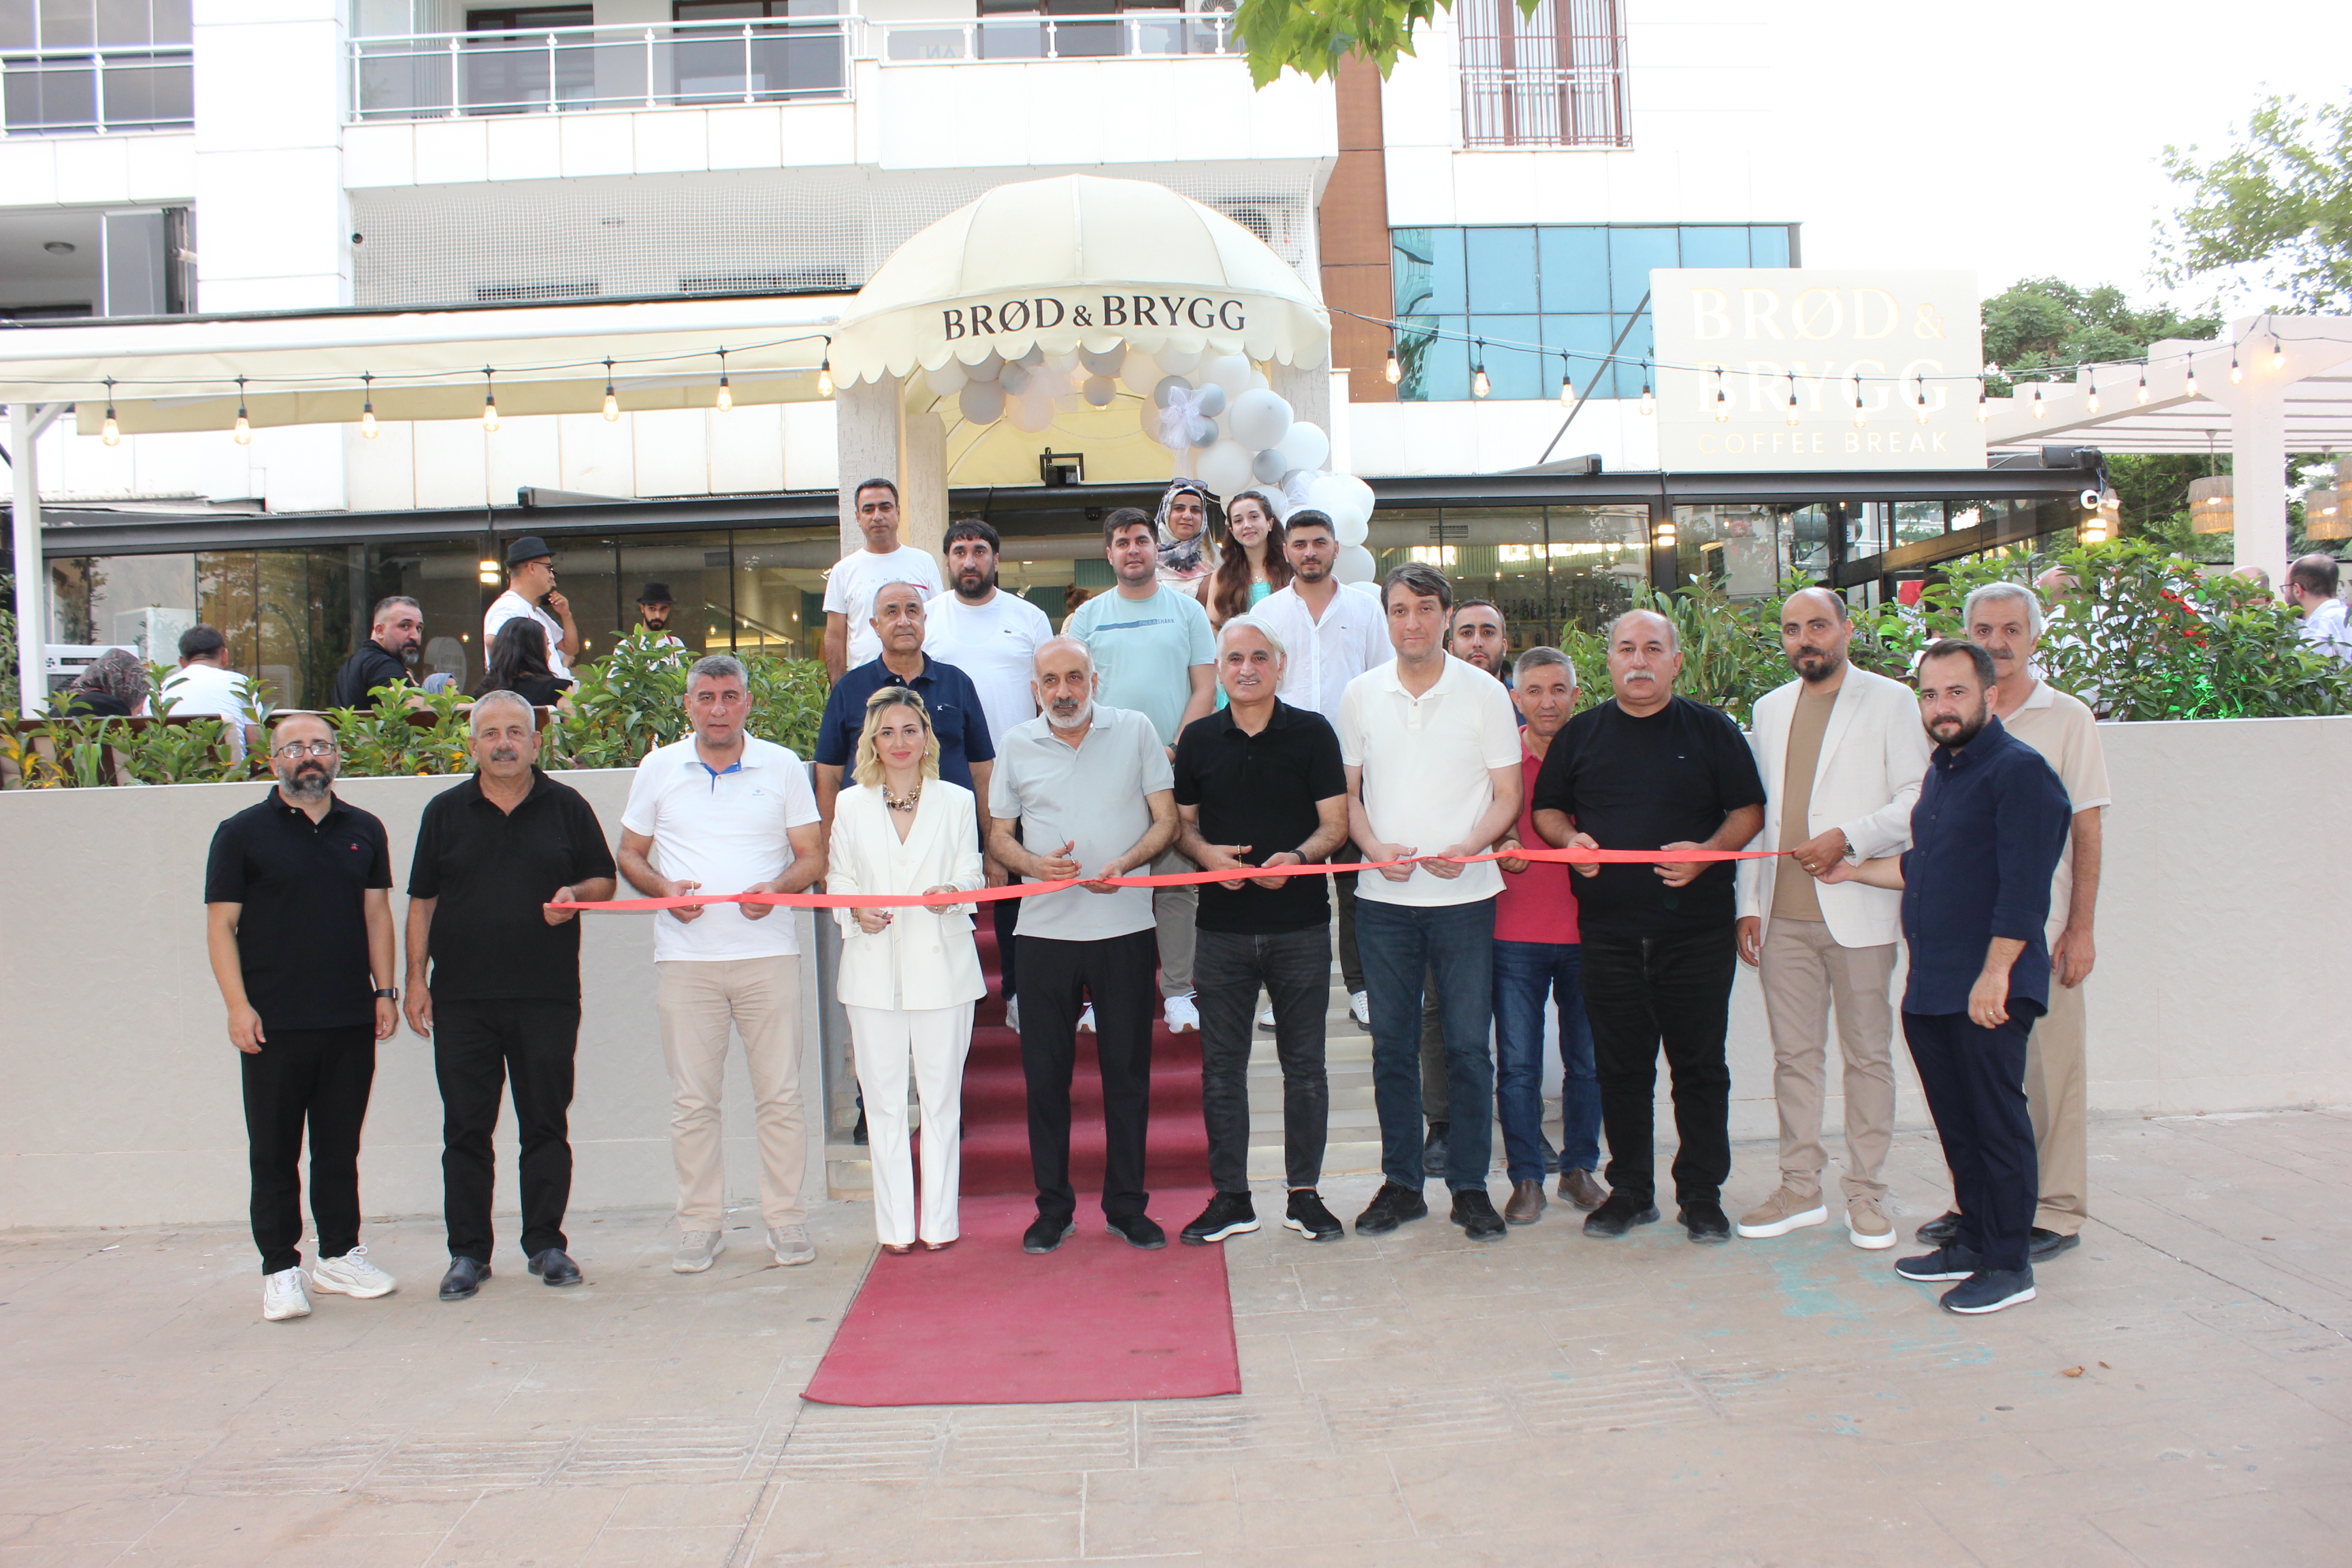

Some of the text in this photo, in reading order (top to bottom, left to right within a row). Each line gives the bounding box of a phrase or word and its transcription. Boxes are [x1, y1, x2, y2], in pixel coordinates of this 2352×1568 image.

[942, 295, 1246, 341] BRØD & BRYGG
[1690, 286, 1947, 341] BRØD &
[1695, 358, 1949, 414] BRYGG
[1697, 431, 1948, 454] COFFEE BREAK
[1412, 545, 1456, 566] BAR
[1499, 544, 1531, 563] ICE
[860, 577, 912, 586] TOMMY
